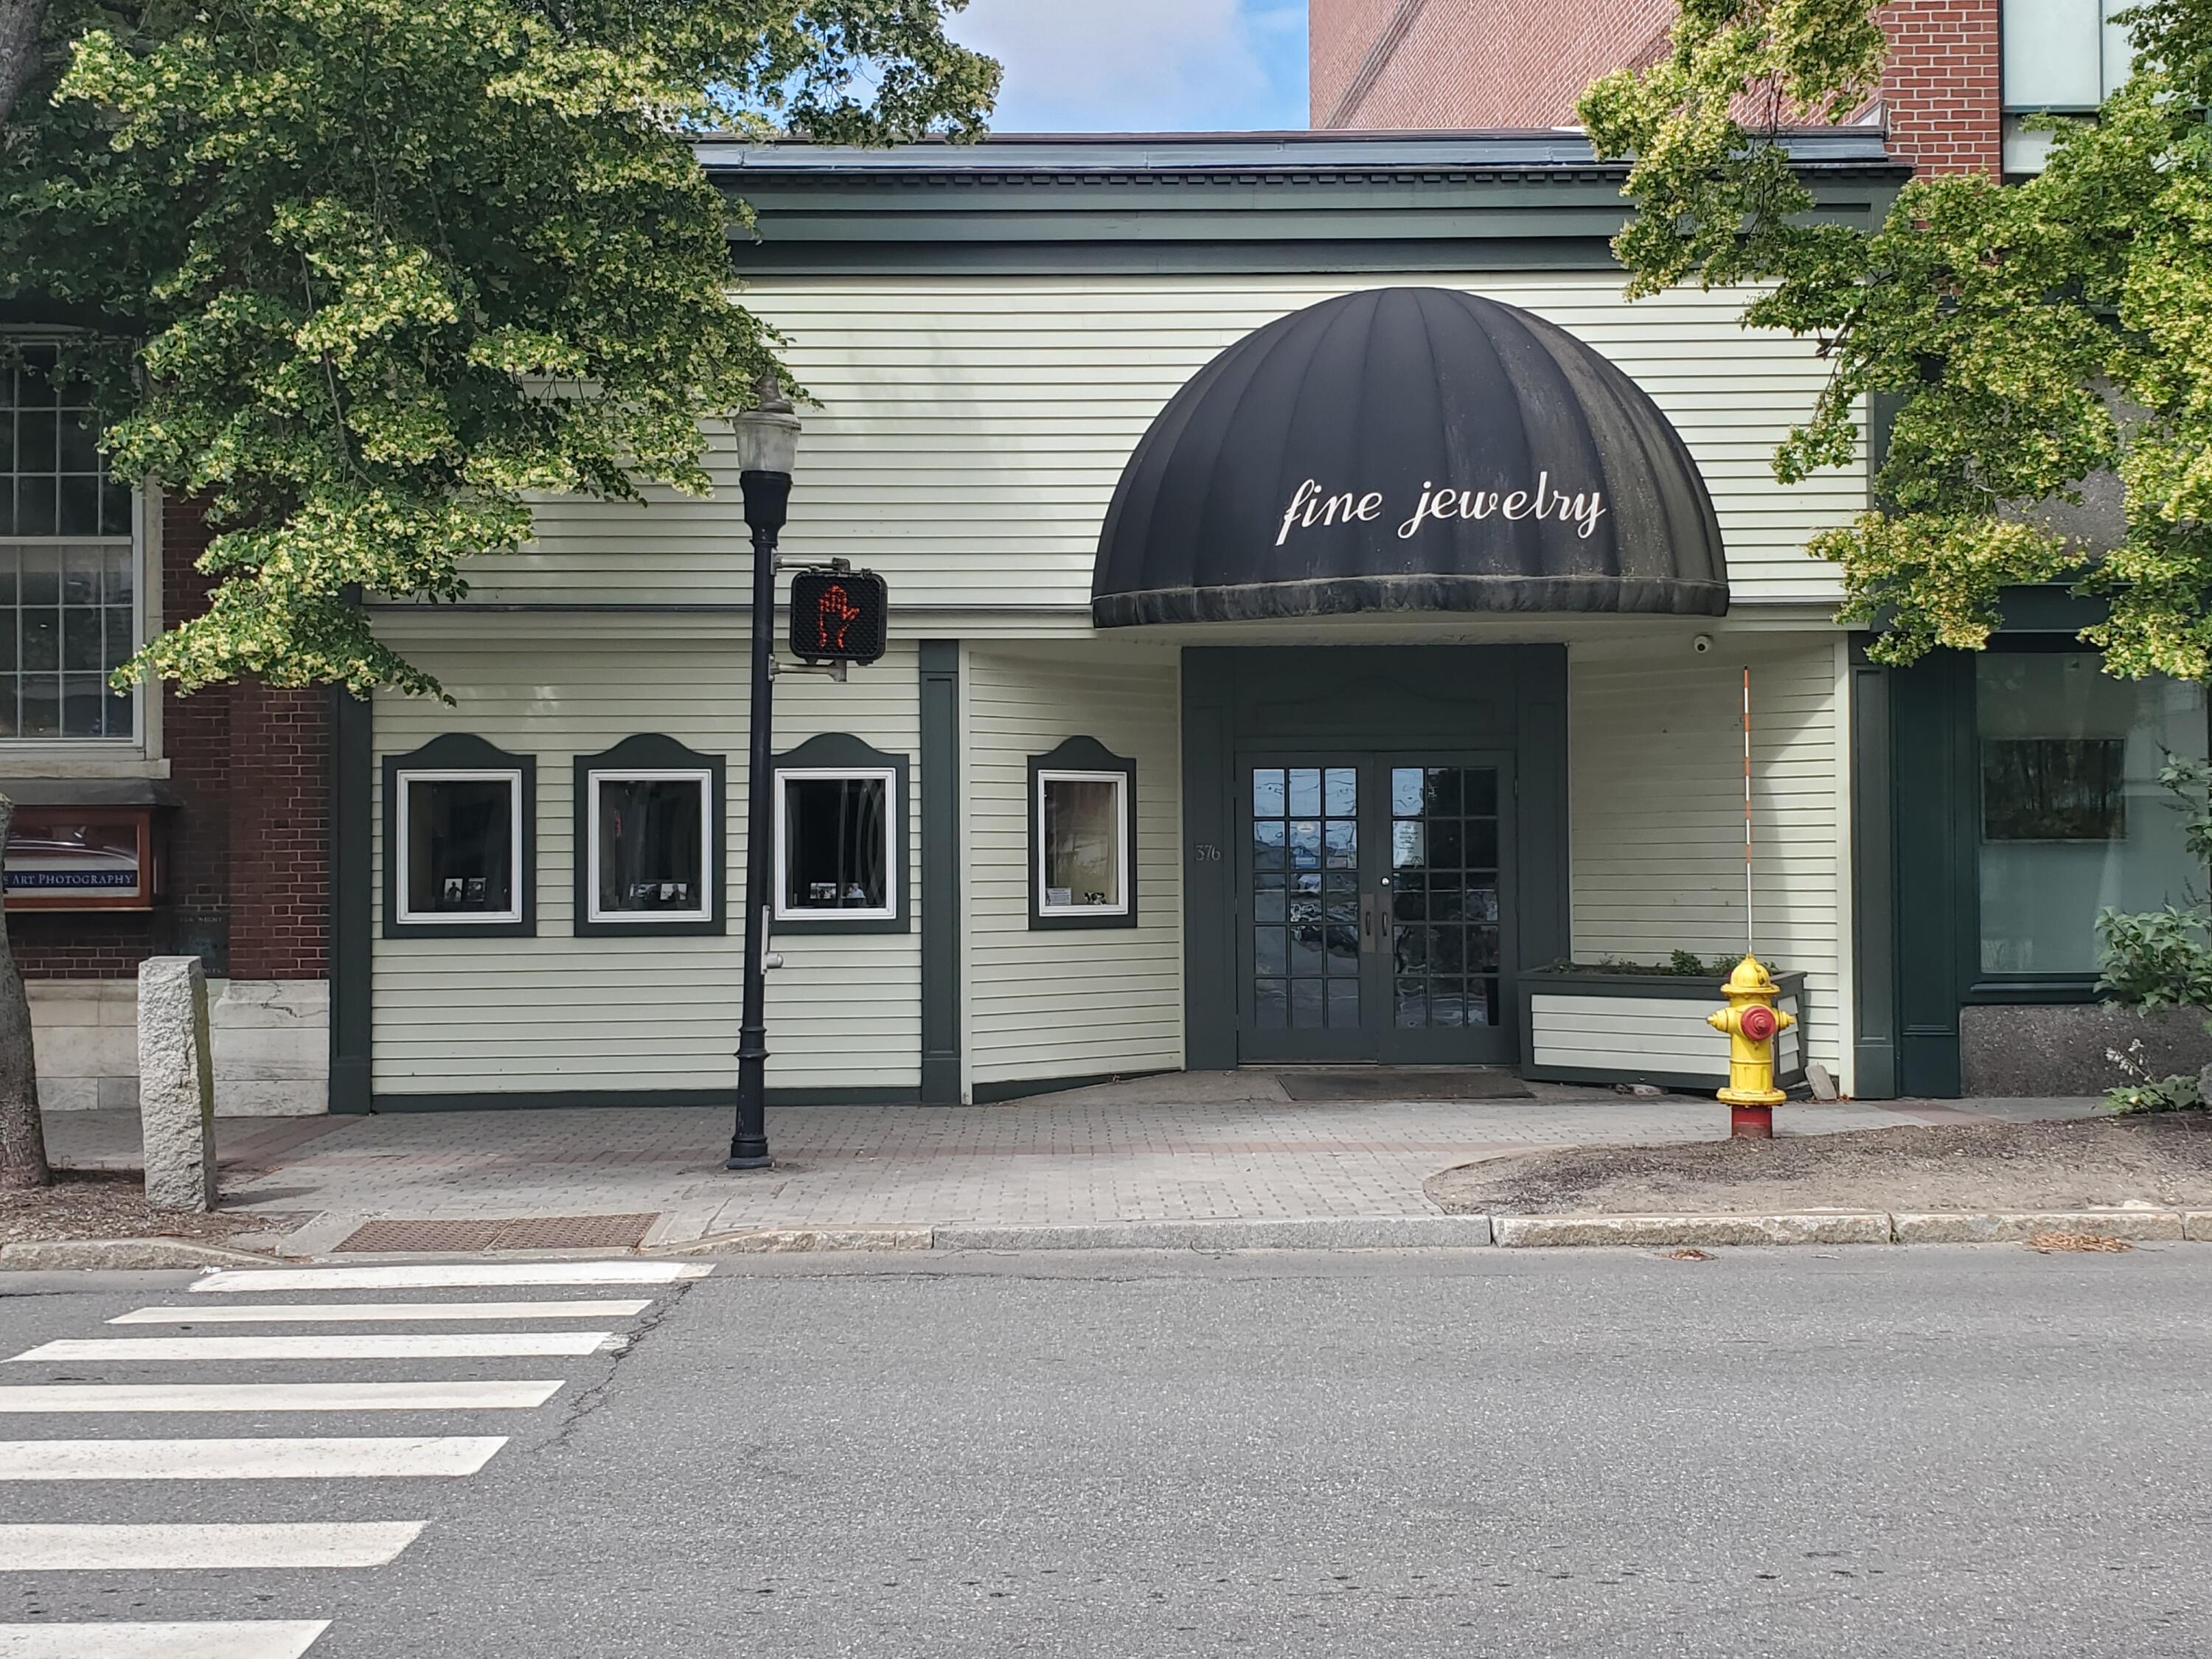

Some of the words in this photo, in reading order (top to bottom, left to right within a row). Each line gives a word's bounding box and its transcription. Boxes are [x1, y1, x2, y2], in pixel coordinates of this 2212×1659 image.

[1275, 478, 1383, 546] fine
[1397, 470, 1607, 539] jewelry
[1195, 844, 1221, 861] 376
[13, 874, 35, 885] ART
[38, 872, 133, 885] PHOTOGRAPHY
